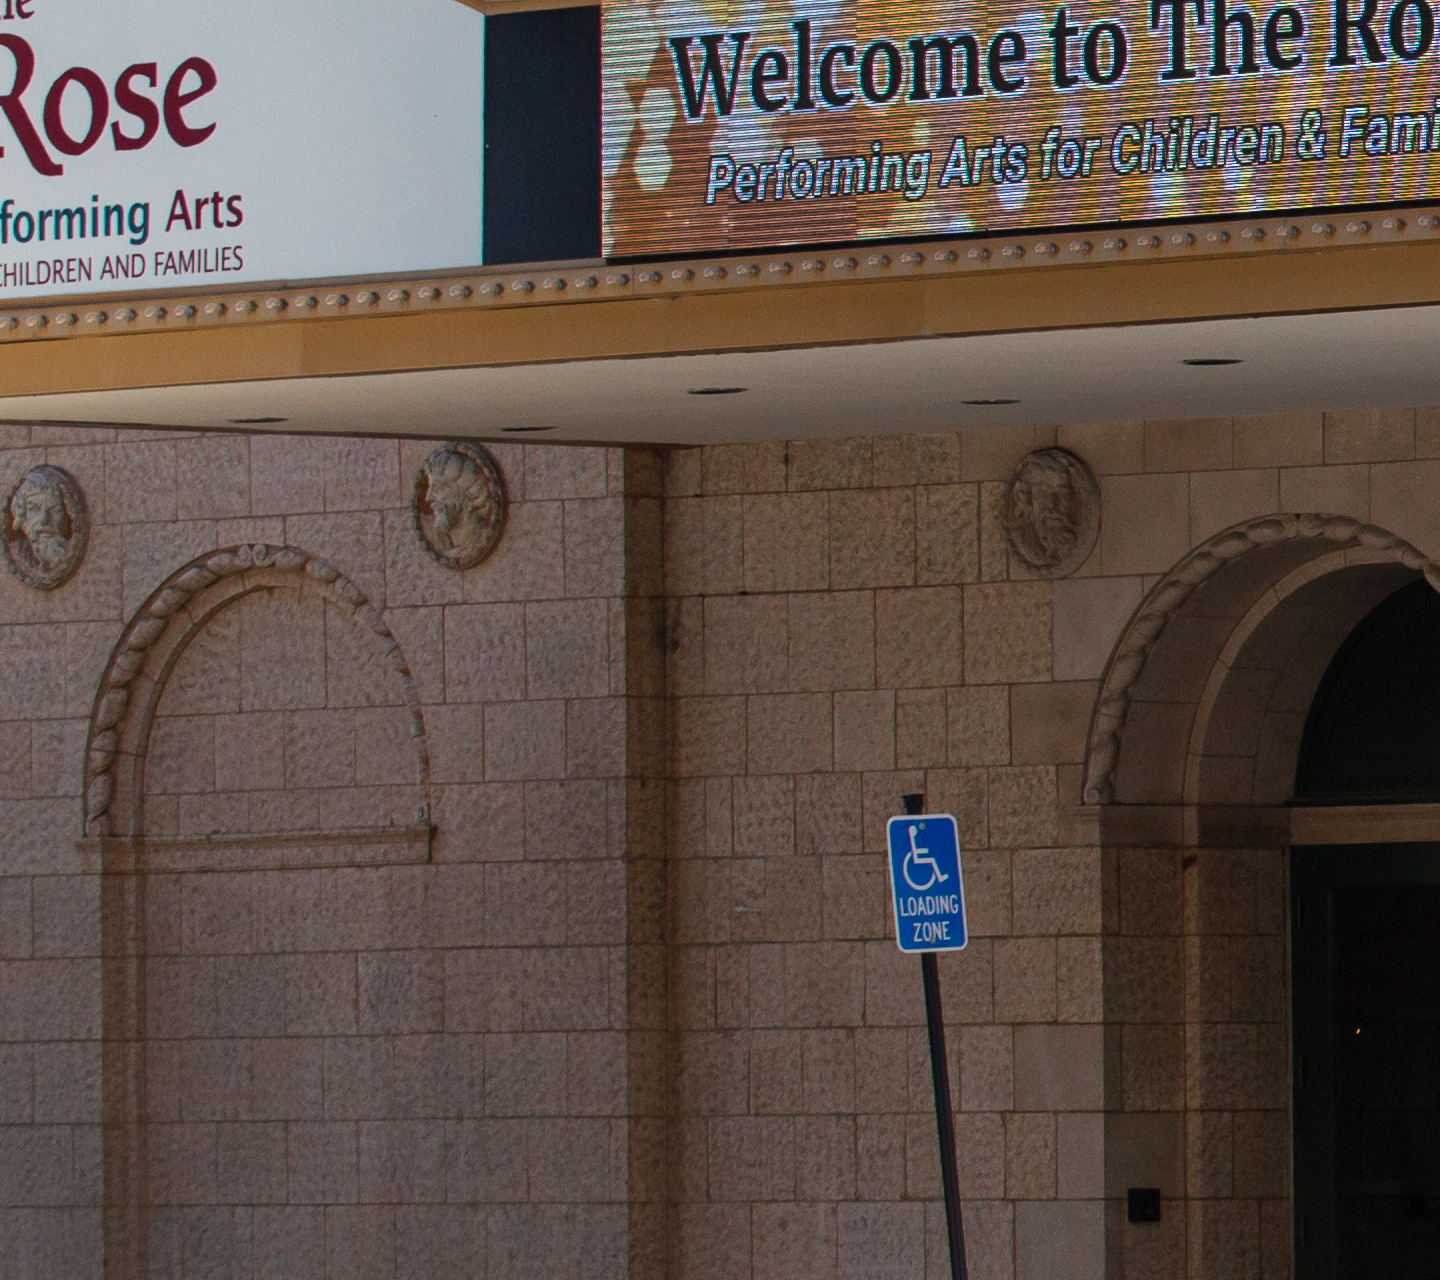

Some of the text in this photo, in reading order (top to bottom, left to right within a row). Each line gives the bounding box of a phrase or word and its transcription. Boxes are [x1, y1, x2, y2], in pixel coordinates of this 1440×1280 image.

[671, 4, 1027, 120] Welcome
[1050, 7, 1127, 87] to
[704, 141, 930, 205] Performing
[938, 137, 1028, 189] Arts
[1041, 126, 1102, 180] for
[1111, 115, 1285, 174] Children
[1296, 110, 1326, 158] &
[0, 189, 244, 245] forming Arts
[0, 245, 244, 287] HILDREN AND FAMILIES
[899, 894, 959, 917] LOADING
[913, 921, 951, 943] ZONE
